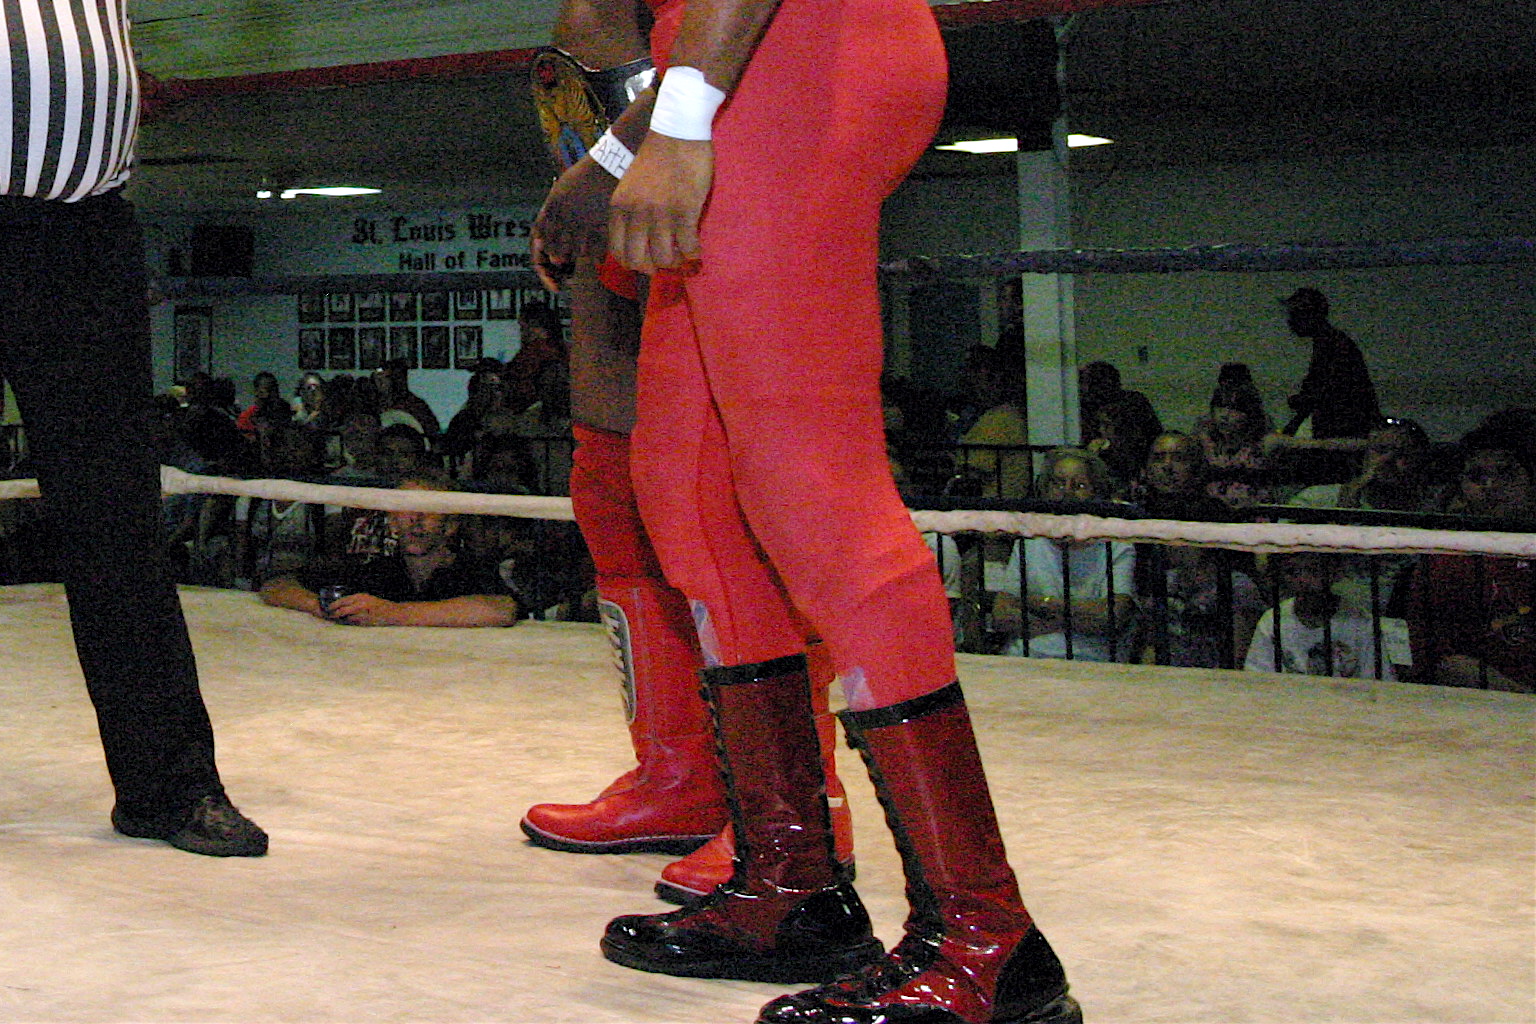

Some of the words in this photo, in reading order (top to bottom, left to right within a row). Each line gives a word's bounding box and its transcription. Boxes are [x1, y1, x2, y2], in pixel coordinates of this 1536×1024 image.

[392, 215, 457, 242] Louis
[398, 252, 435, 271] Hall
[445, 251, 465, 269] of
[476, 250, 532, 269] Fame
